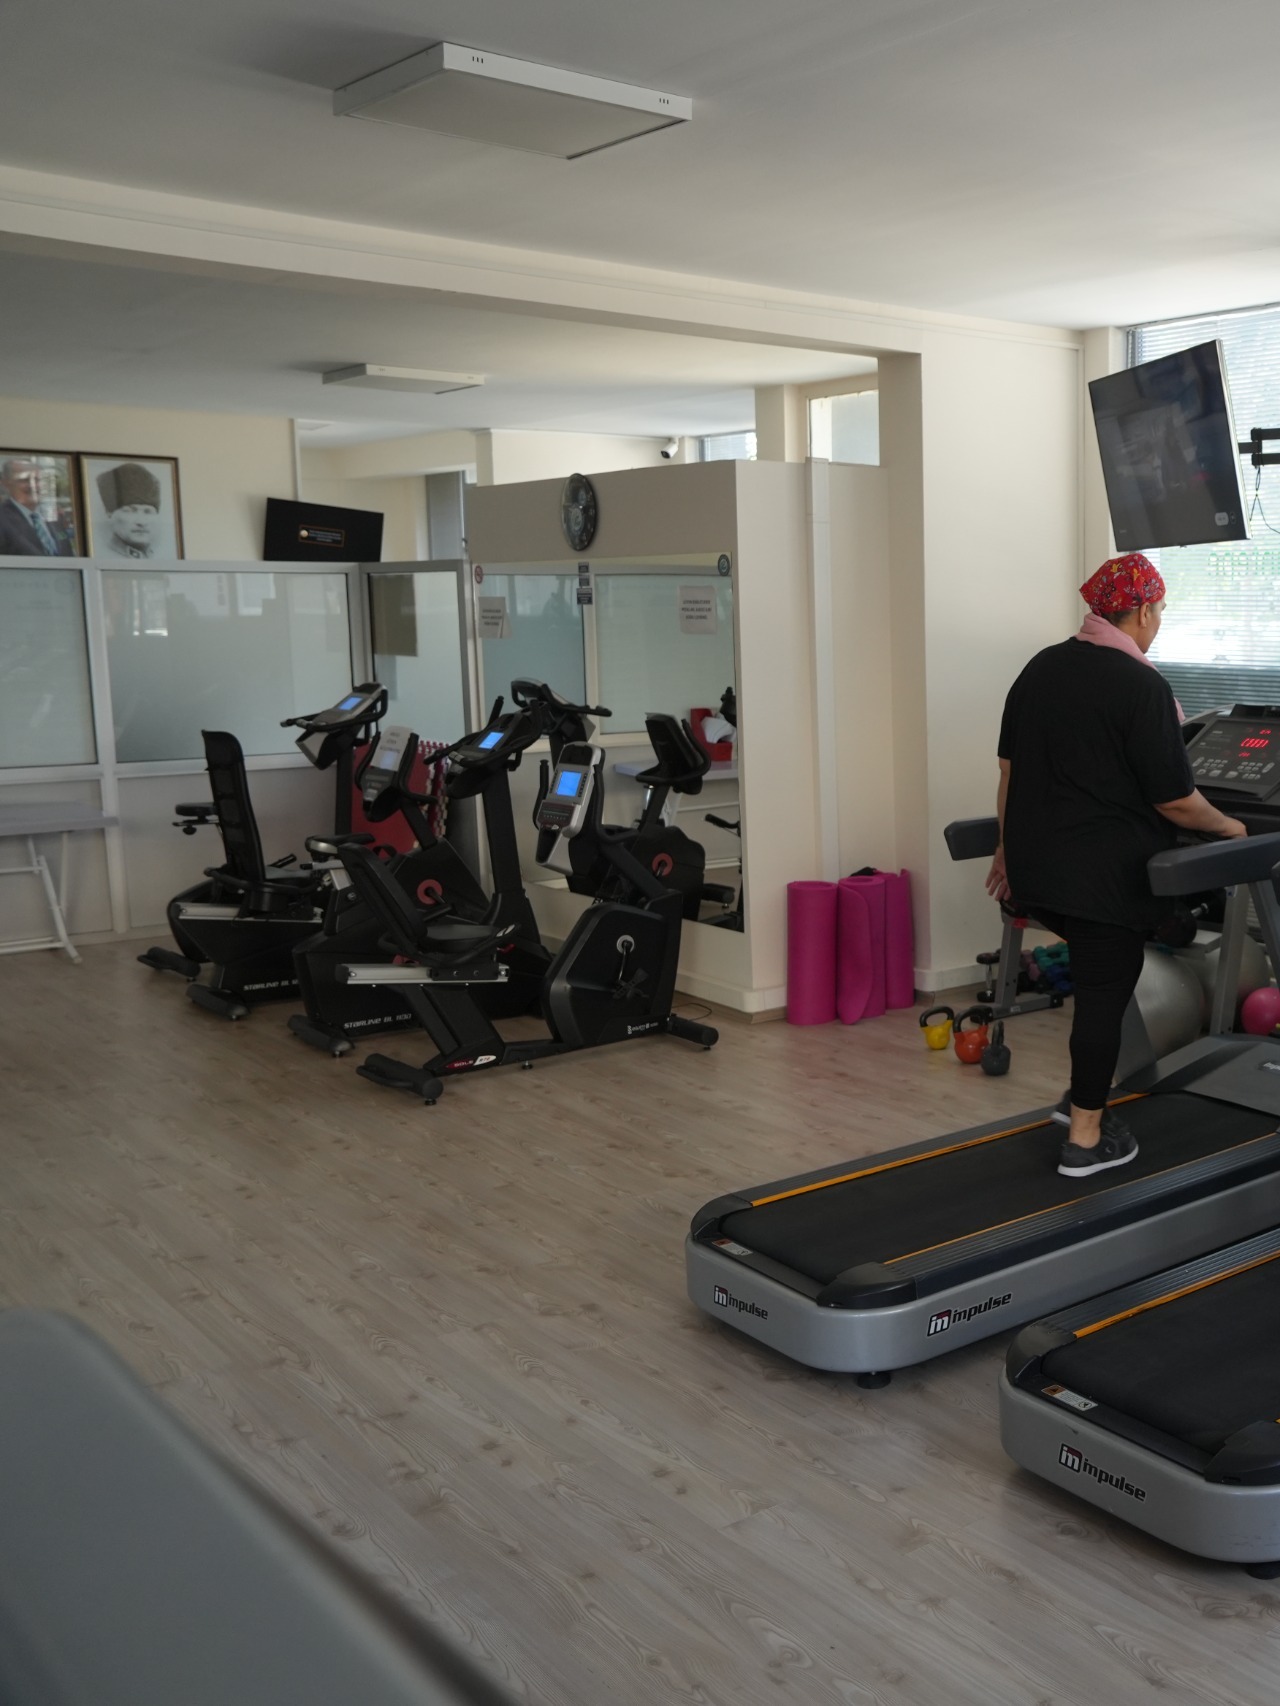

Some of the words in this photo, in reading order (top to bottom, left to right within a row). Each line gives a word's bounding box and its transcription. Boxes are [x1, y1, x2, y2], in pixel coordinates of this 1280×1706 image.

[728, 1292, 769, 1321] impulse
[952, 1292, 1013, 1324] impulse
[1083, 1458, 1146, 1502] impulse
